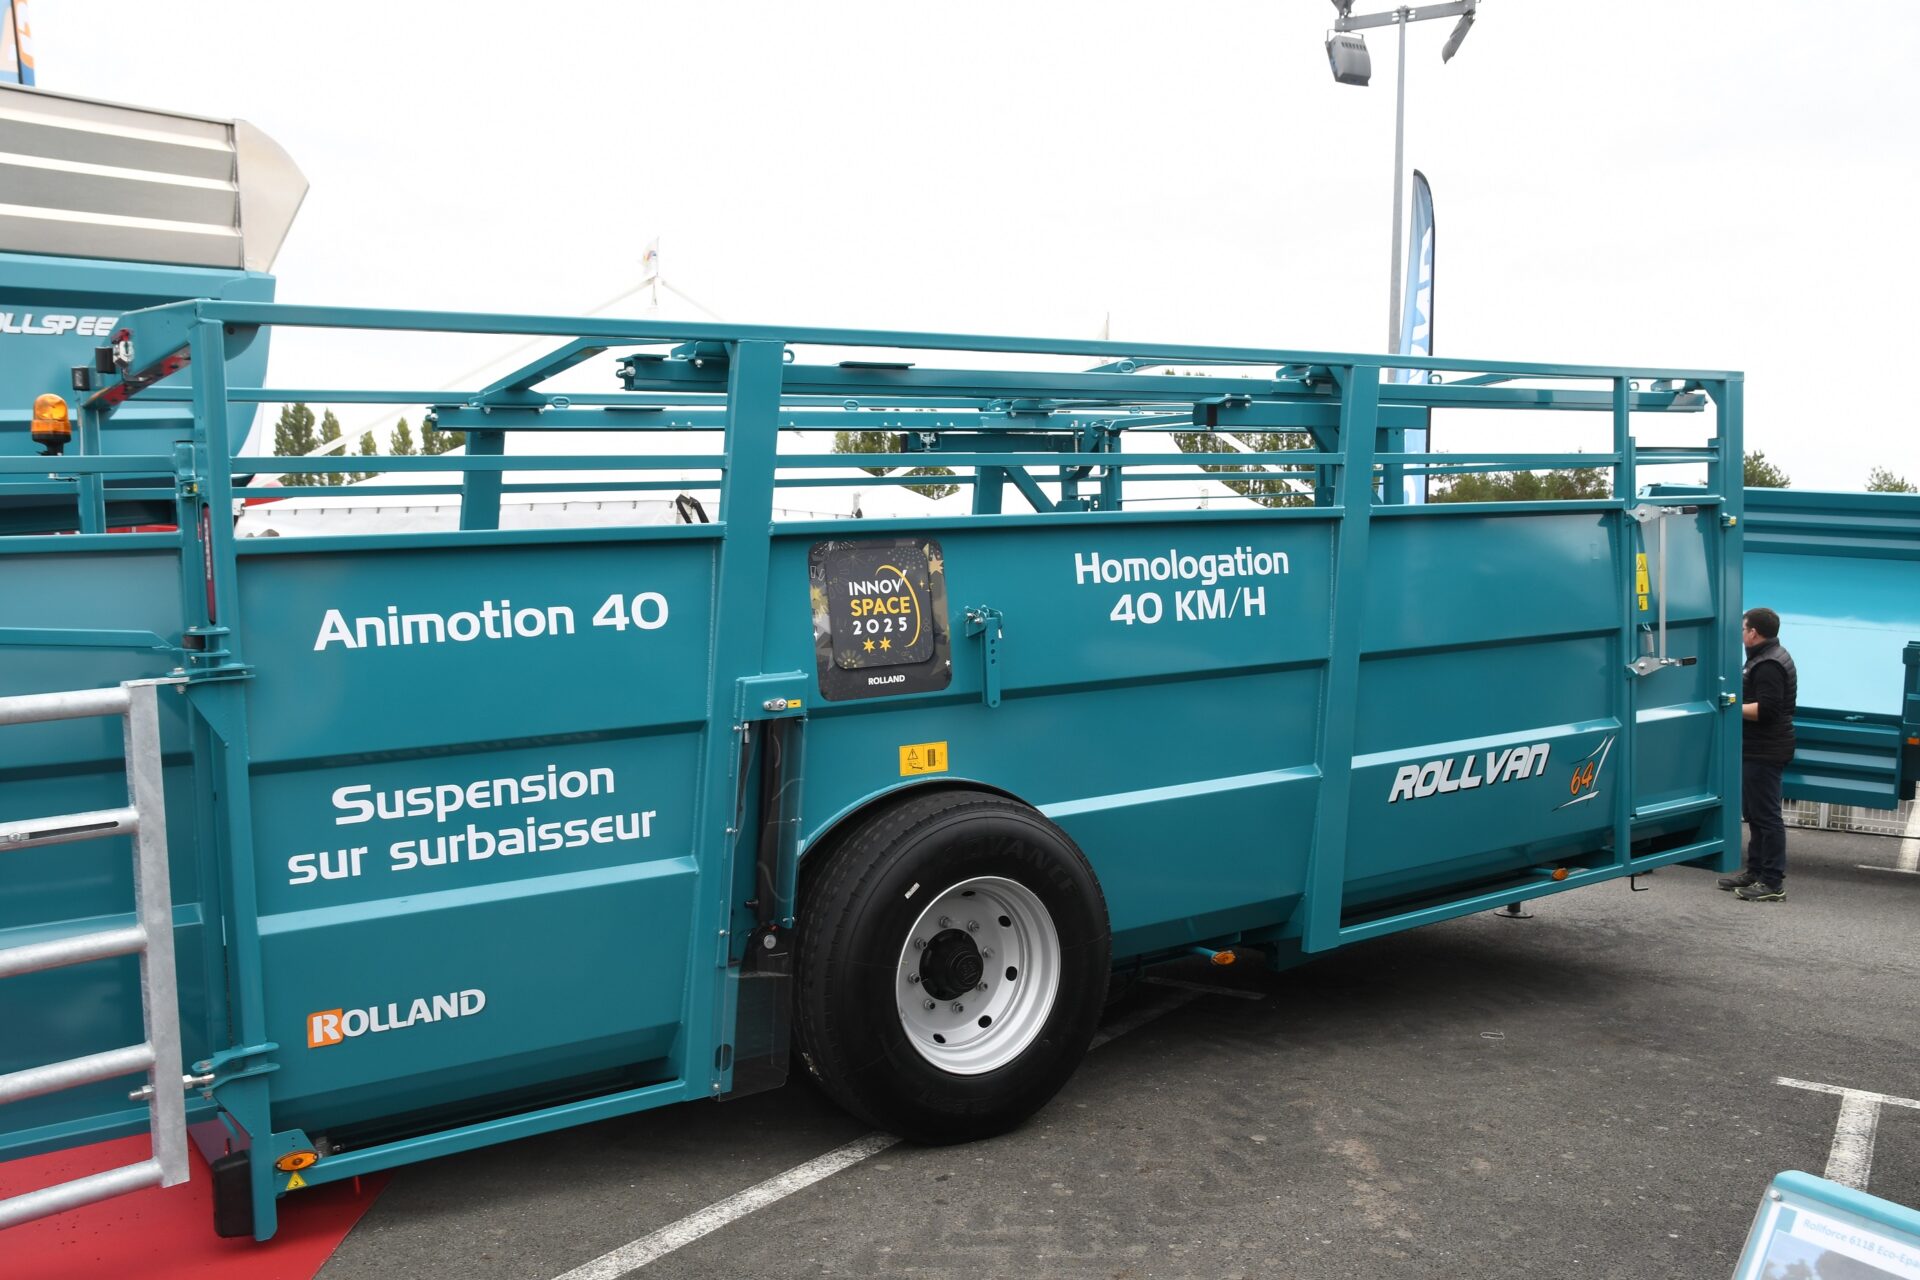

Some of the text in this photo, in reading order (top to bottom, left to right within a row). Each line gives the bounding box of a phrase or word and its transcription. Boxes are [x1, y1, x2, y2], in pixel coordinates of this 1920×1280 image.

[0, 313, 119, 337] LLSPEE
[1075, 546, 1290, 587] Homologation
[314, 591, 669, 651] Animotion 40
[850, 596, 911, 617] SPACE
[1109, 586, 1267, 625] 40 KM/H
[868, 674, 906, 686] ROLLAND
[332, 764, 615, 826] Suspension
[1388, 742, 1594, 803] ROLLVAN 64
[287, 810, 657, 886] sur surbaisseur
[309, 988, 486, 1044] ROLLAND
